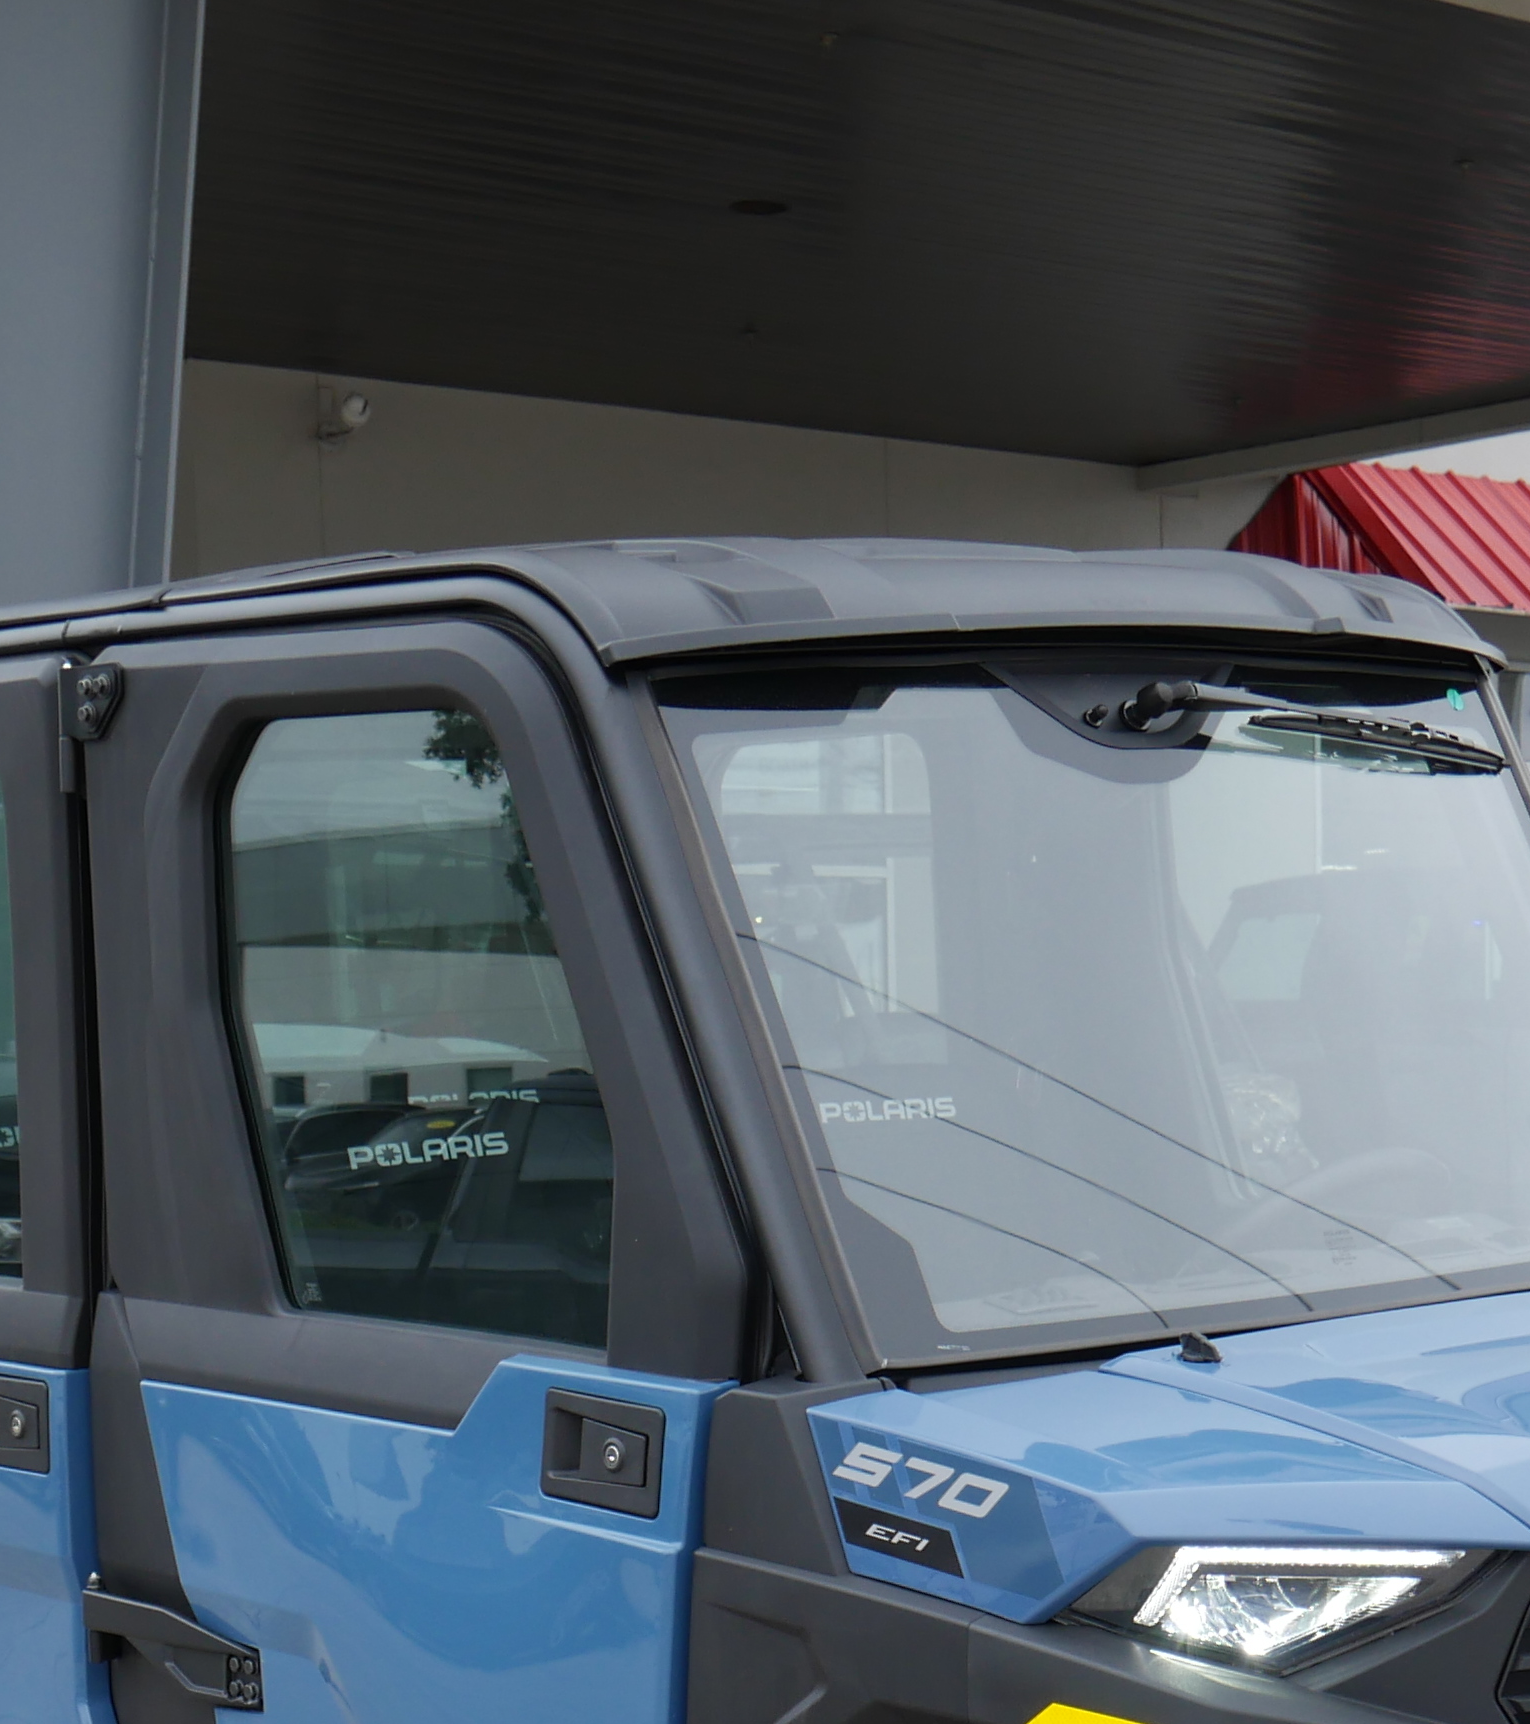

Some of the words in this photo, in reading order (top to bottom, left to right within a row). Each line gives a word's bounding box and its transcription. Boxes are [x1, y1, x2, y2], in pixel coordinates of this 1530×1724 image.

[819, 1097, 956, 1123] POLARIS
[347, 1131, 510, 1170] POLARIS
[832, 1442, 1009, 1519] 570
[865, 1524, 930, 1552] EFI
